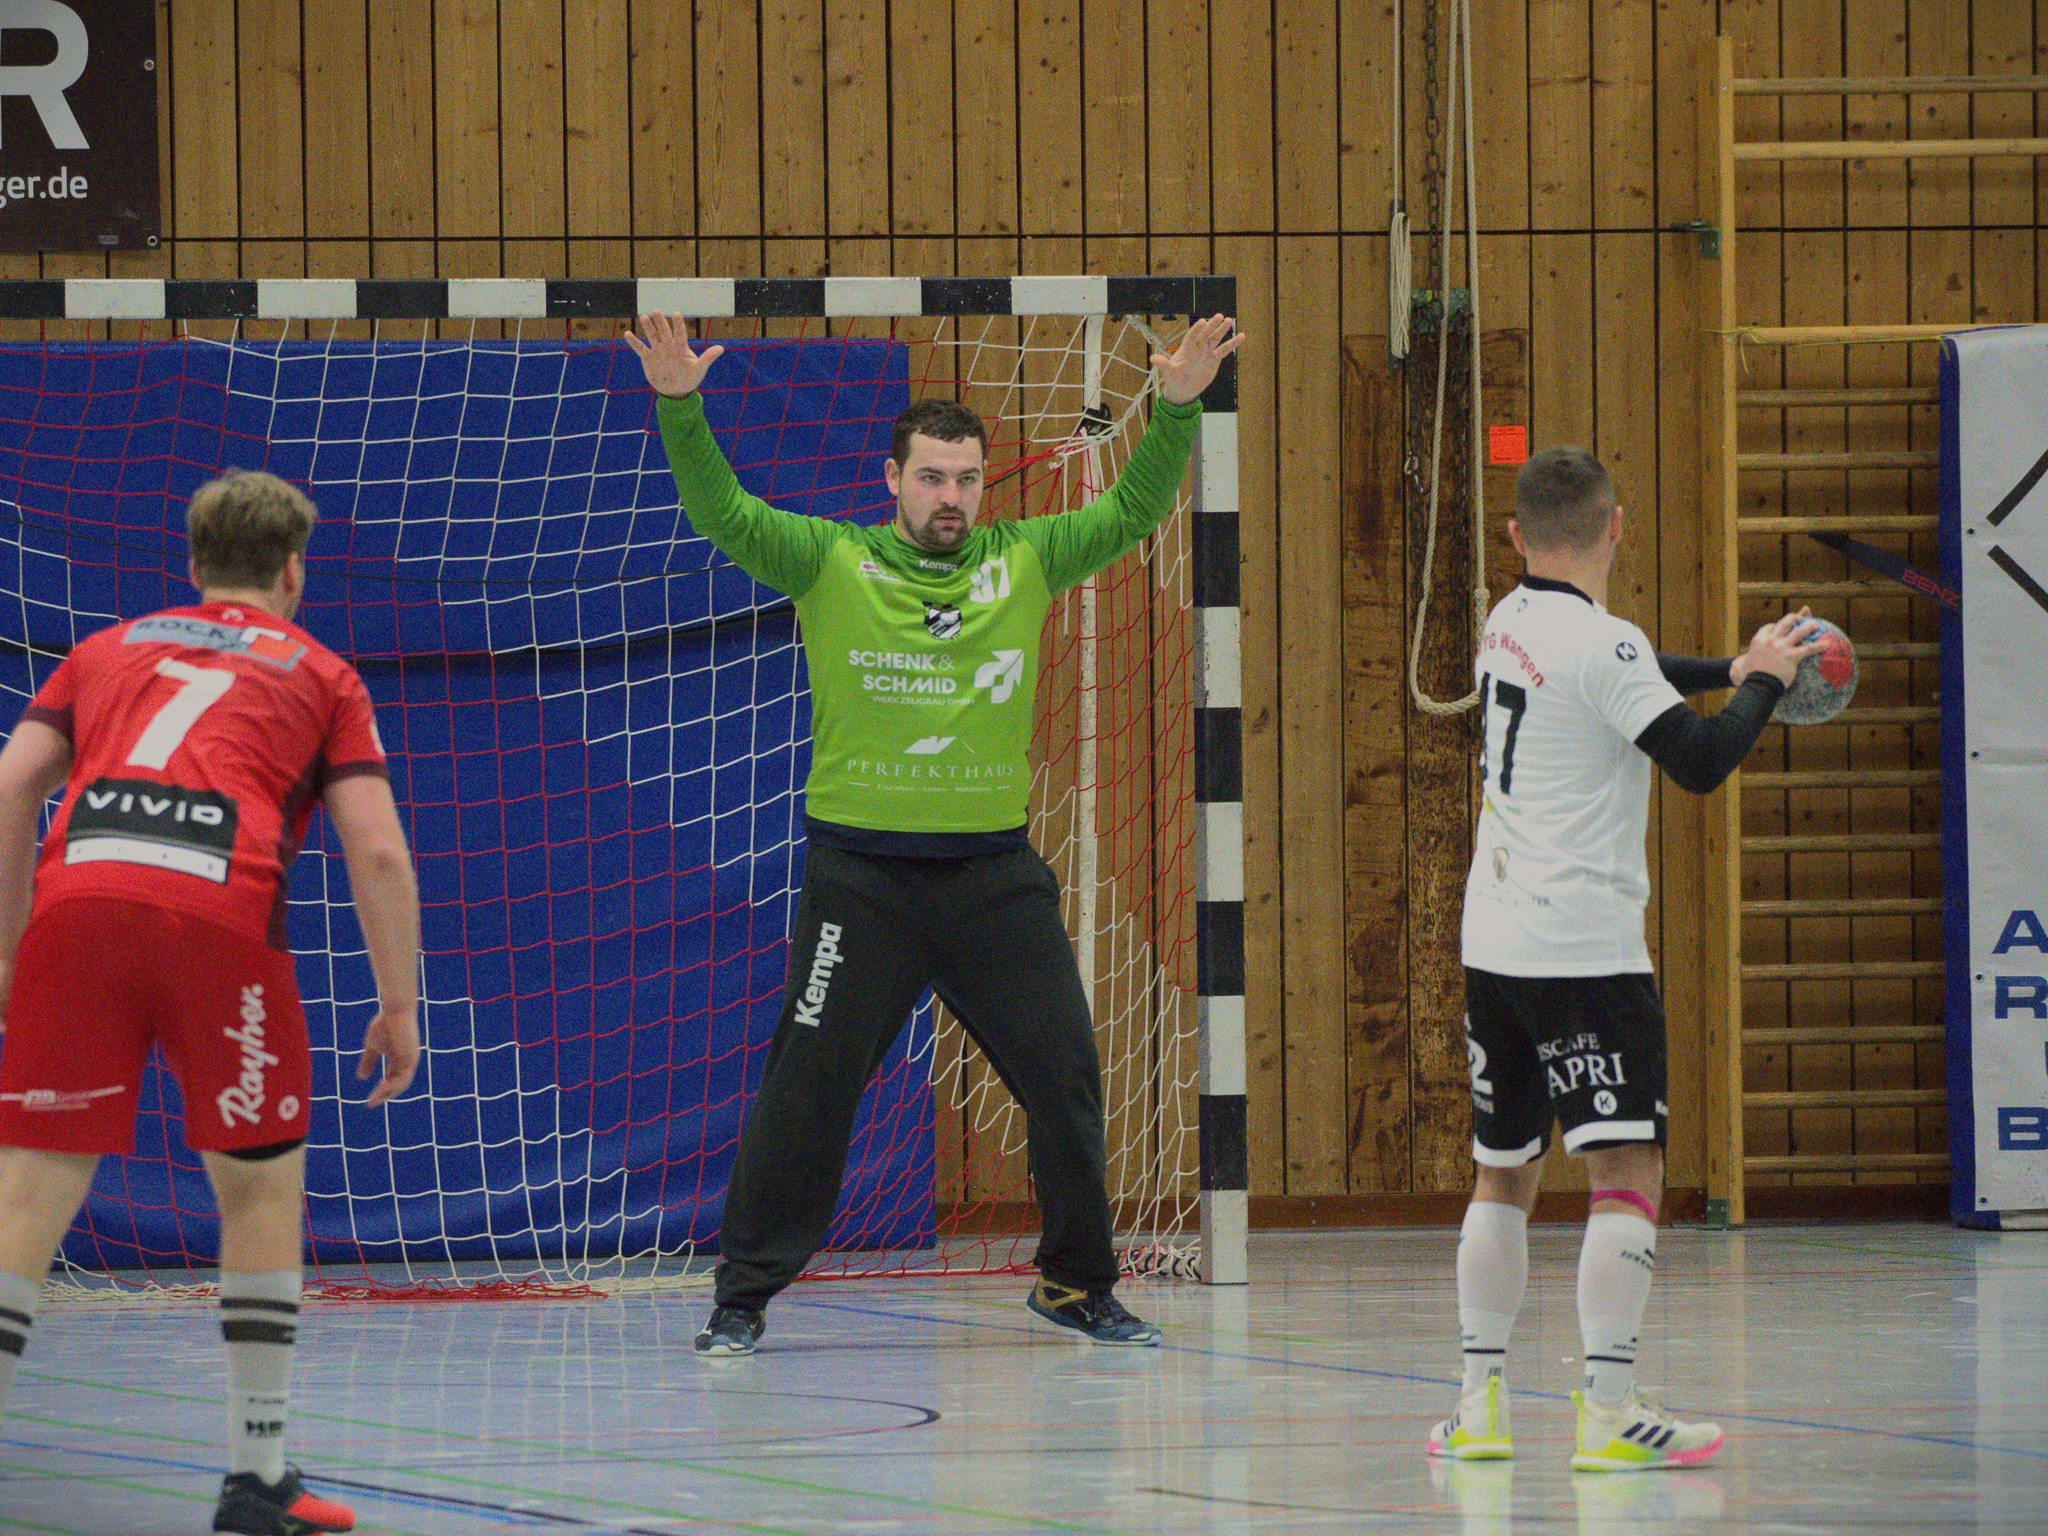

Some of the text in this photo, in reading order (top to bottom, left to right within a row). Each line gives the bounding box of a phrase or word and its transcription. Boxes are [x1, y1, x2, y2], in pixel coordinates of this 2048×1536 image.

[0, 0, 91, 150] R
[1902, 567, 1961, 608] BENZ
[848, 648, 956, 672] SCHENK &
[862, 673, 958, 695] SCHMID
[1501, 632, 1545, 689] Wangen
[125, 656, 237, 772] 7
[847, 759, 1014, 779] PERFEKTHAUS
[794, 921, 845, 1028] Kempa
